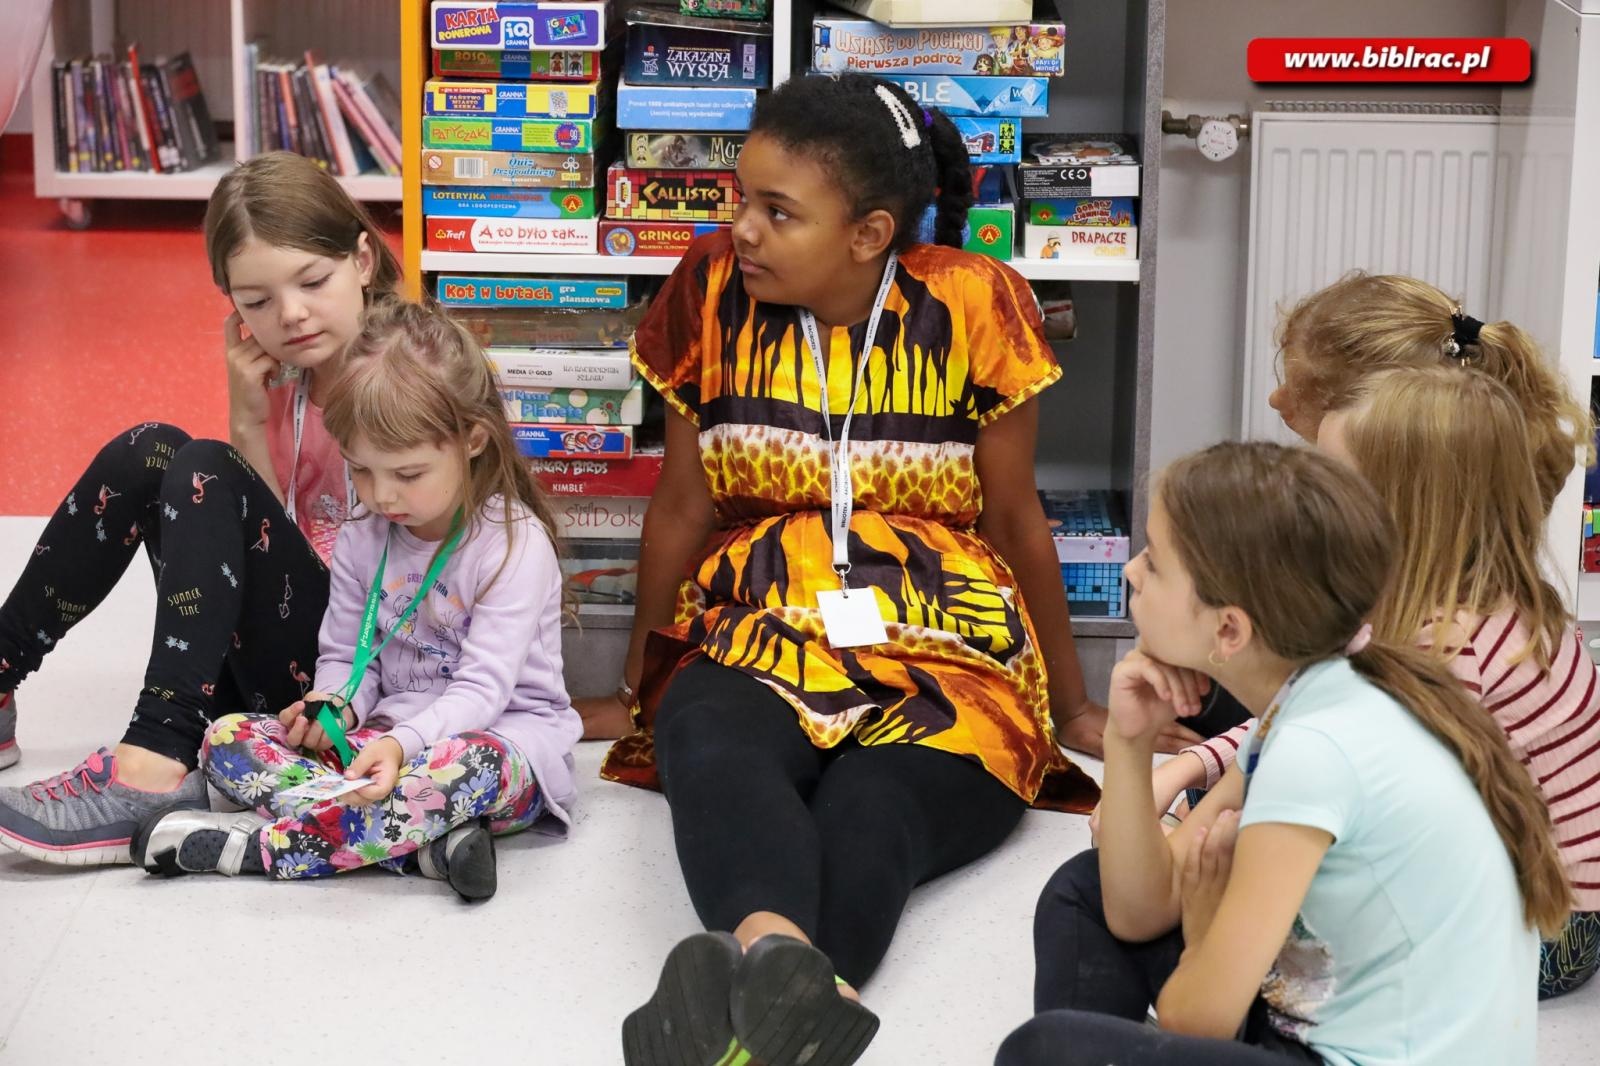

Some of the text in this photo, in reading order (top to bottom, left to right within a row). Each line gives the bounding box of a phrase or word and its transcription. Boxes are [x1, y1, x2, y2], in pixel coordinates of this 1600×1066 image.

[445, 8, 499, 30] KARTA
[438, 25, 492, 41] ROWEROWA
[505, 23, 532, 38] iQ
[667, 49, 731, 64] ZAKAZANA
[847, 56, 909, 69] Pierwsza
[666, 61, 729, 81] WYSPA
[904, 81, 952, 102] BLE
[508, 157, 535, 167] Quiz
[492, 167, 556, 177] Przyrodniczy
[432, 191, 487, 200] LOTERYJKA
[642, 181, 721, 205] CALLISTO
[446, 229, 466, 240] Trefl
[479, 225, 493, 239] A
[497, 227, 514, 238] to
[518, 227, 548, 239] było
[638, 230, 691, 241] GRINGO
[1071, 231, 1127, 244] DRAPACZE
[445, 284, 553, 300] Kot w butach
[560, 285, 575, 295] gra
[559, 295, 610, 305] planszowa
[516, 430, 546, 438] GRANNA
[530, 460, 608, 476] ANGRY BIRDS
[552, 483, 584, 493] KIMBLE
[564, 504, 641, 528] SuDok
